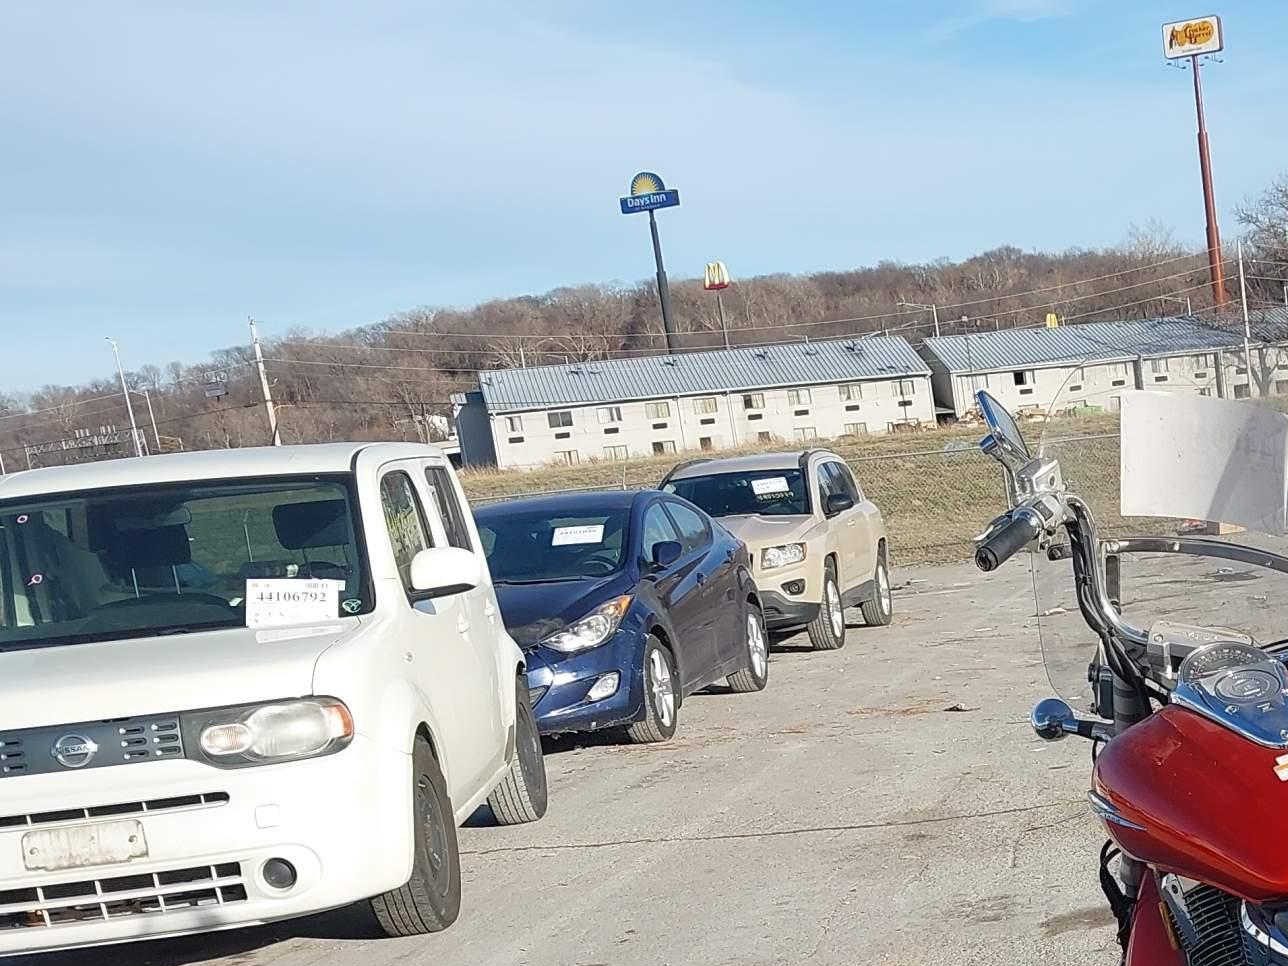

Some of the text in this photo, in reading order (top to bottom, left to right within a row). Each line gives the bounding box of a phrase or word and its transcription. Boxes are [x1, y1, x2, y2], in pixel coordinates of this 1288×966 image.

[627, 196, 650, 208] Days
[650, 193, 667, 203] Inn
[256, 591, 326, 602] 44106792
